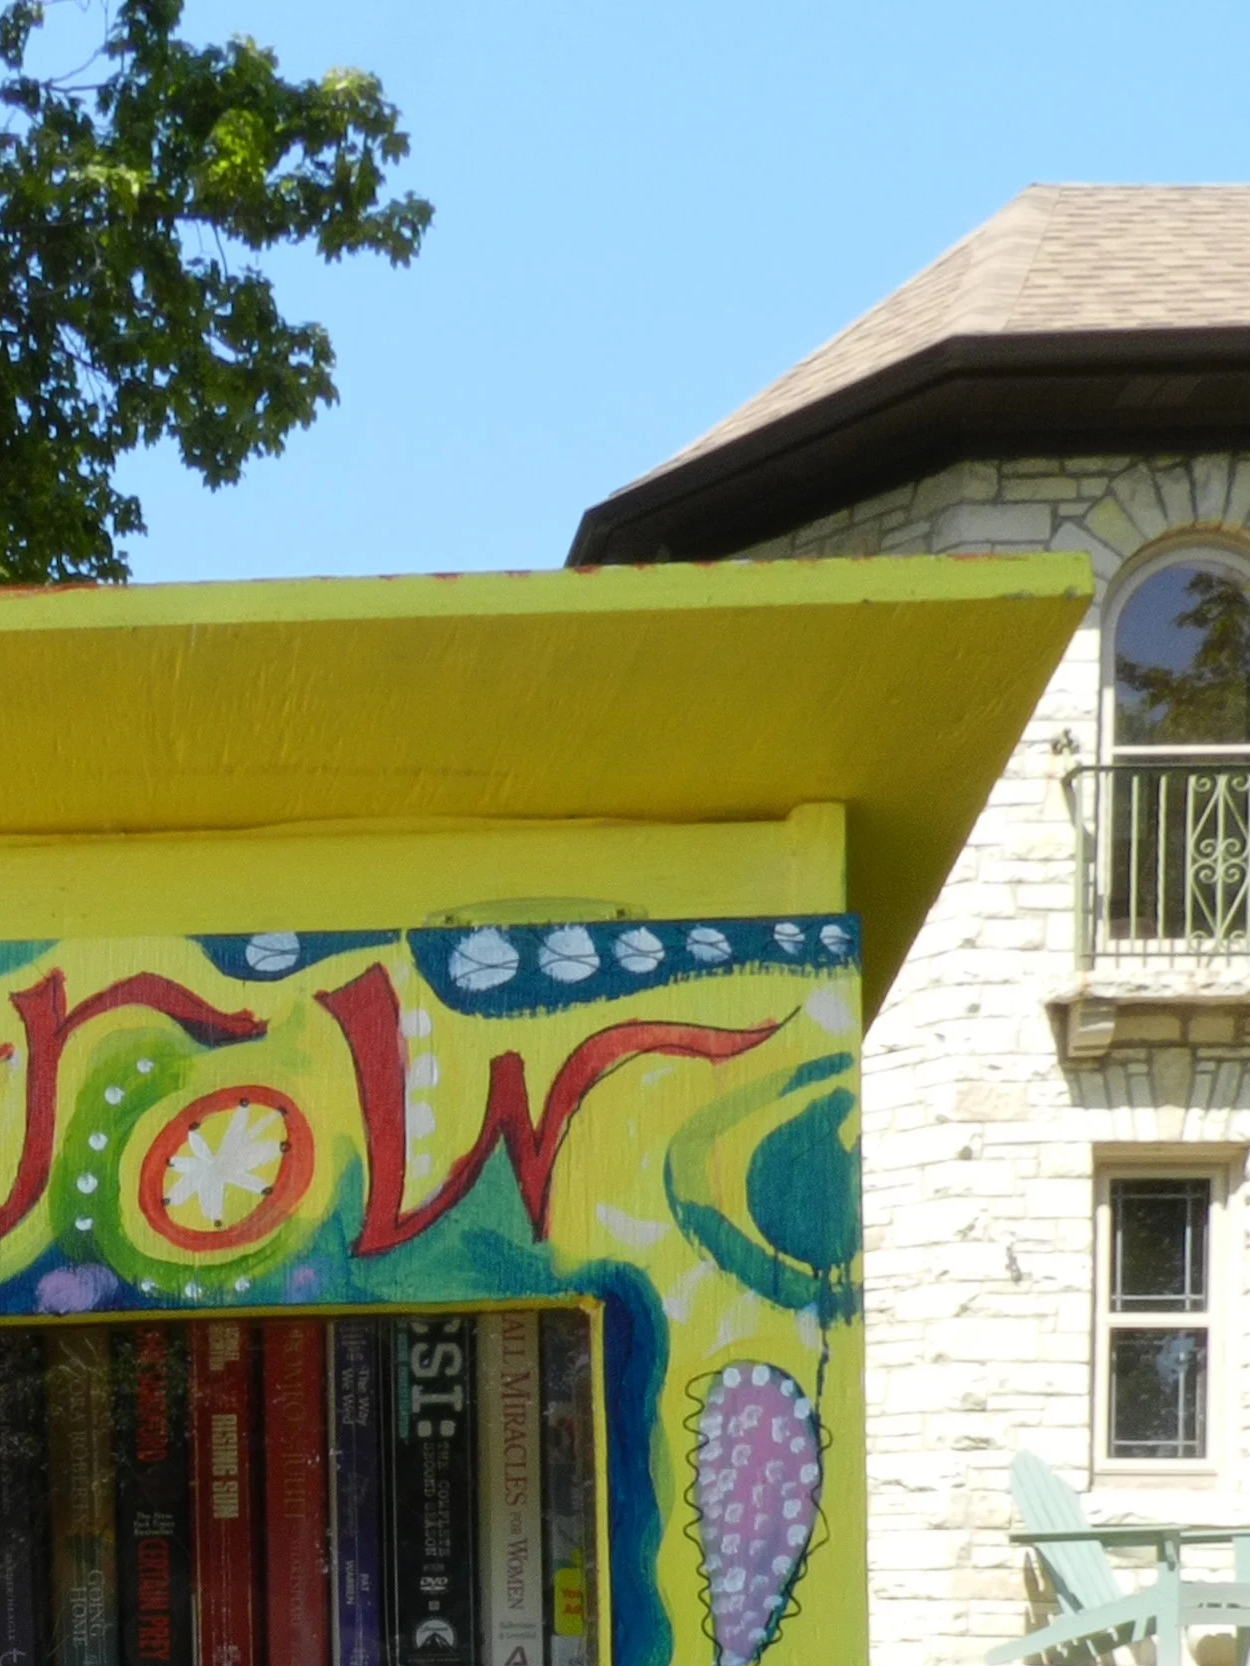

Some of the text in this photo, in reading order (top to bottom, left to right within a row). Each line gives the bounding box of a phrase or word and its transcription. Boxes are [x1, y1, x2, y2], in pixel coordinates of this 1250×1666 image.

[341, 1367, 354, 1389] We
[354, 1397, 369, 1427] Way
[437, 1440, 450, 1470] THE
[500, 1372, 531, 1506] MIRACLES
[211, 1414, 239, 1520] RISING SUN
[137, 1538, 170, 1611] CERTAIN
[359, 1572, 370, 1592] PAT
[507, 1539, 528, 1611] WOMEN
[137, 1615, 170, 1660] PREY
